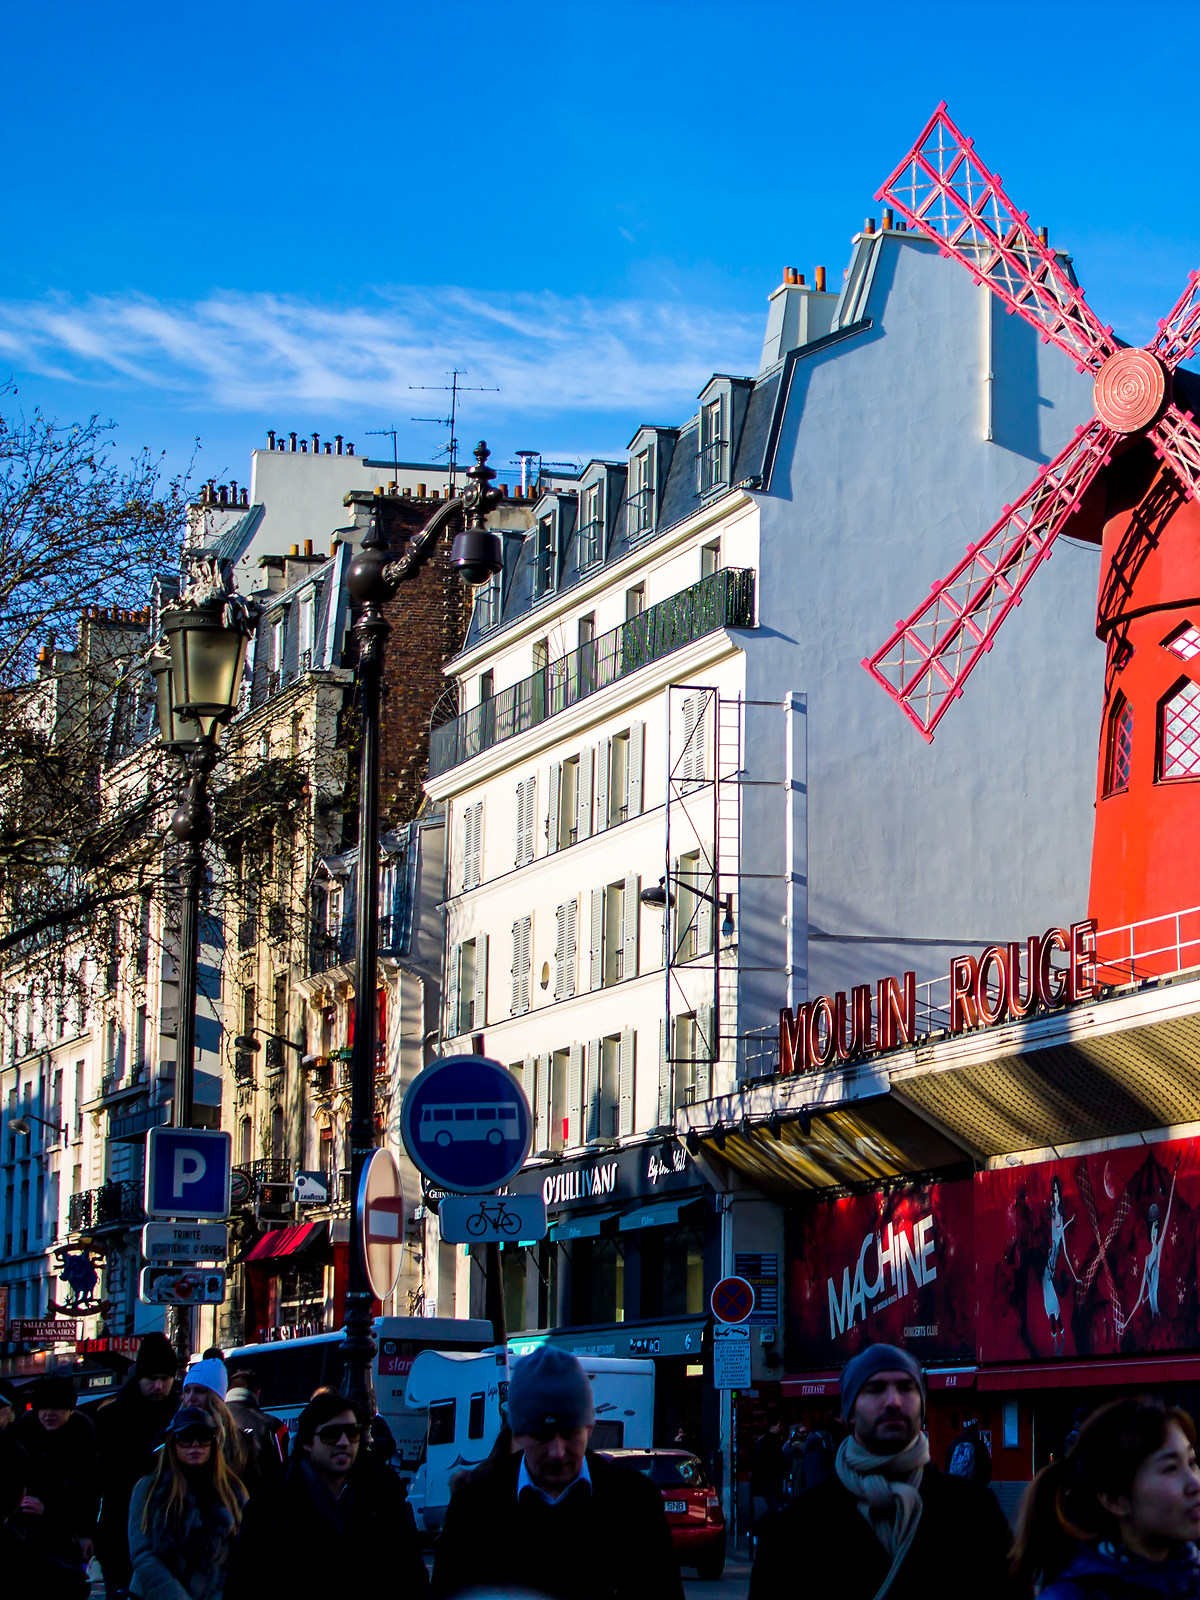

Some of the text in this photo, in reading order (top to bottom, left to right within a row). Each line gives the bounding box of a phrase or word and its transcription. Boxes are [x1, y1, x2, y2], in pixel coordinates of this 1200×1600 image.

[778, 918, 1099, 1075] MOULIN ROUGE
[172, 1147, 207, 1198] P
[543, 1162, 619, 1205] O'SULLIVANS
[827, 1214, 938, 1340] MACHINE
[36, 1328, 75, 1336] LUMINAIRES
[112, 1336, 144, 1353] DEU
[801, 1384, 825, 1395] TERRASSE
[945, 1375, 957, 1387] BAR
